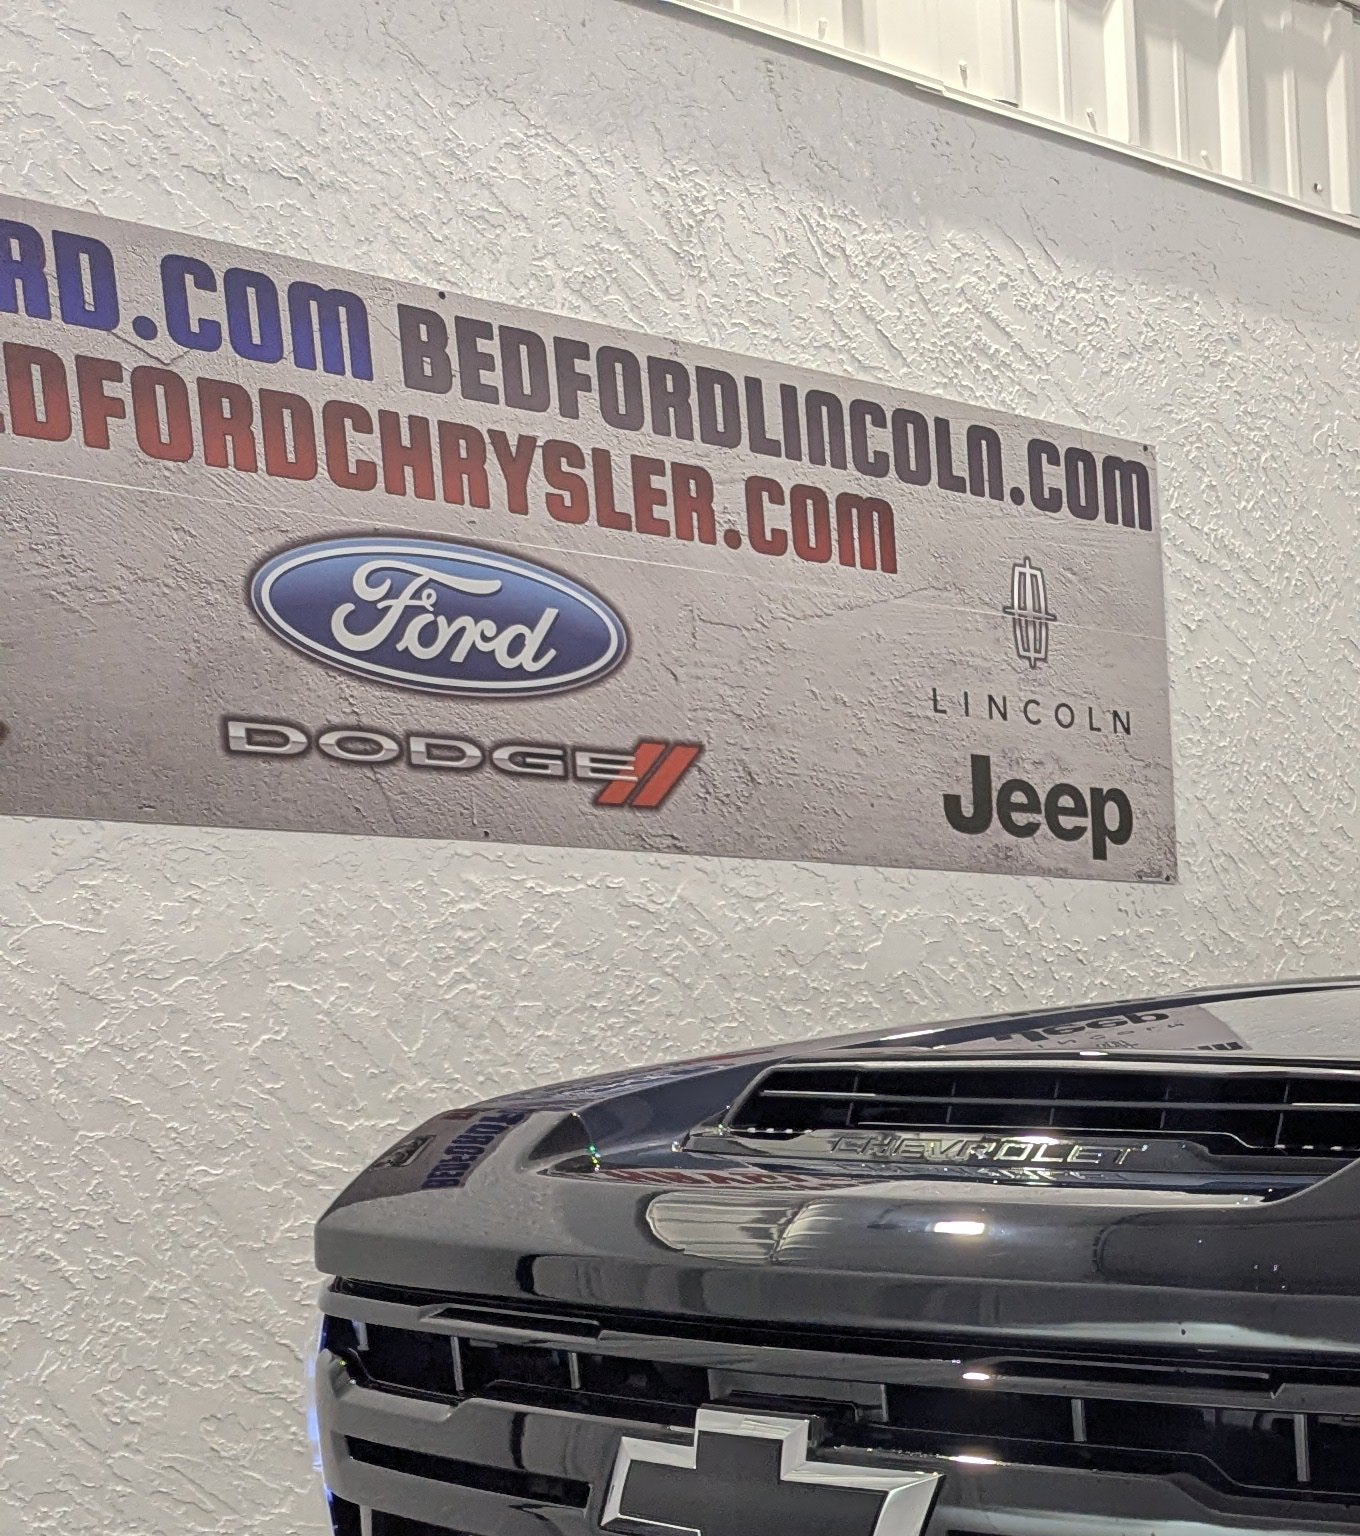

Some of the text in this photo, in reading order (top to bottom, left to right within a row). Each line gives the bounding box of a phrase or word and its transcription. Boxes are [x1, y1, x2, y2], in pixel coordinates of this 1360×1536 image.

[0, 341, 898, 574] DFORDCHRYSLER.COM
[399, 303, 1152, 533] BEDFORDLINCOLN.COM
[330, 559, 560, 673] Ford
[226, 720, 639, 784] DODGE
[931, 687, 1131, 735] LINCOLN
[942, 754, 1134, 861] Jeep
[830, 1136, 1149, 1166] CHEVROLET
